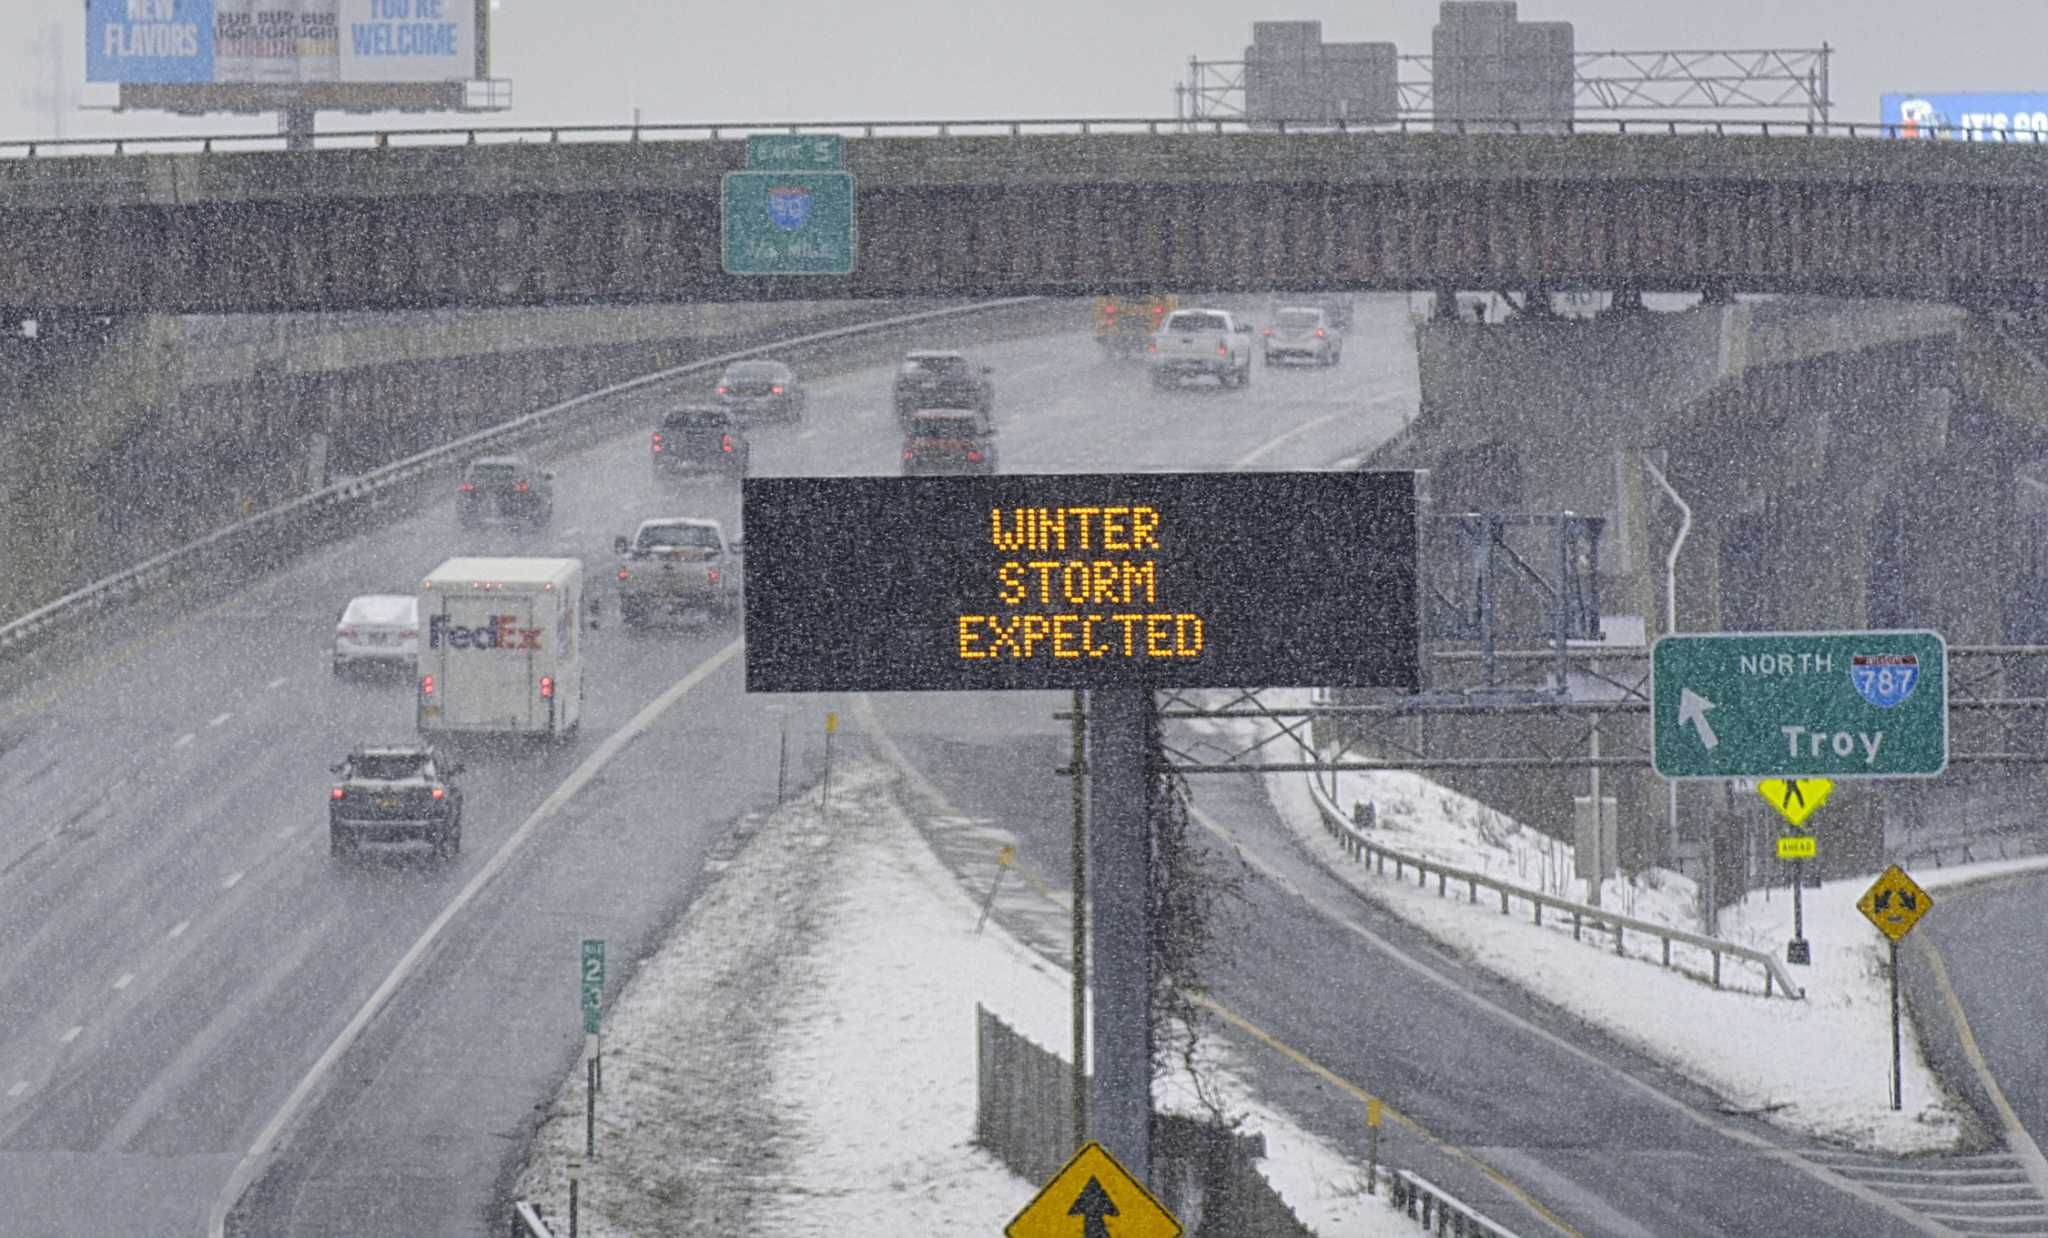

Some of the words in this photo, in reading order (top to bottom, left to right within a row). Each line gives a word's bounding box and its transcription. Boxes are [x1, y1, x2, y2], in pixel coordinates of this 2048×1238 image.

[370, 0, 442, 18] YOURE
[105, 24, 197, 56] FLAVORS
[351, 24, 457, 56] WELCOME
[1962, 112, 2008, 143] IT'S
[992, 506, 1160, 551] WINTER
[999, 560, 1155, 604] STORM
[429, 614, 543, 651] FedEx
[959, 613, 1204, 658] EXPECTED
[1739, 653, 1833, 675] NORTH
[1860, 669, 1912, 696] 787
[1781, 725, 1884, 765] Troy
